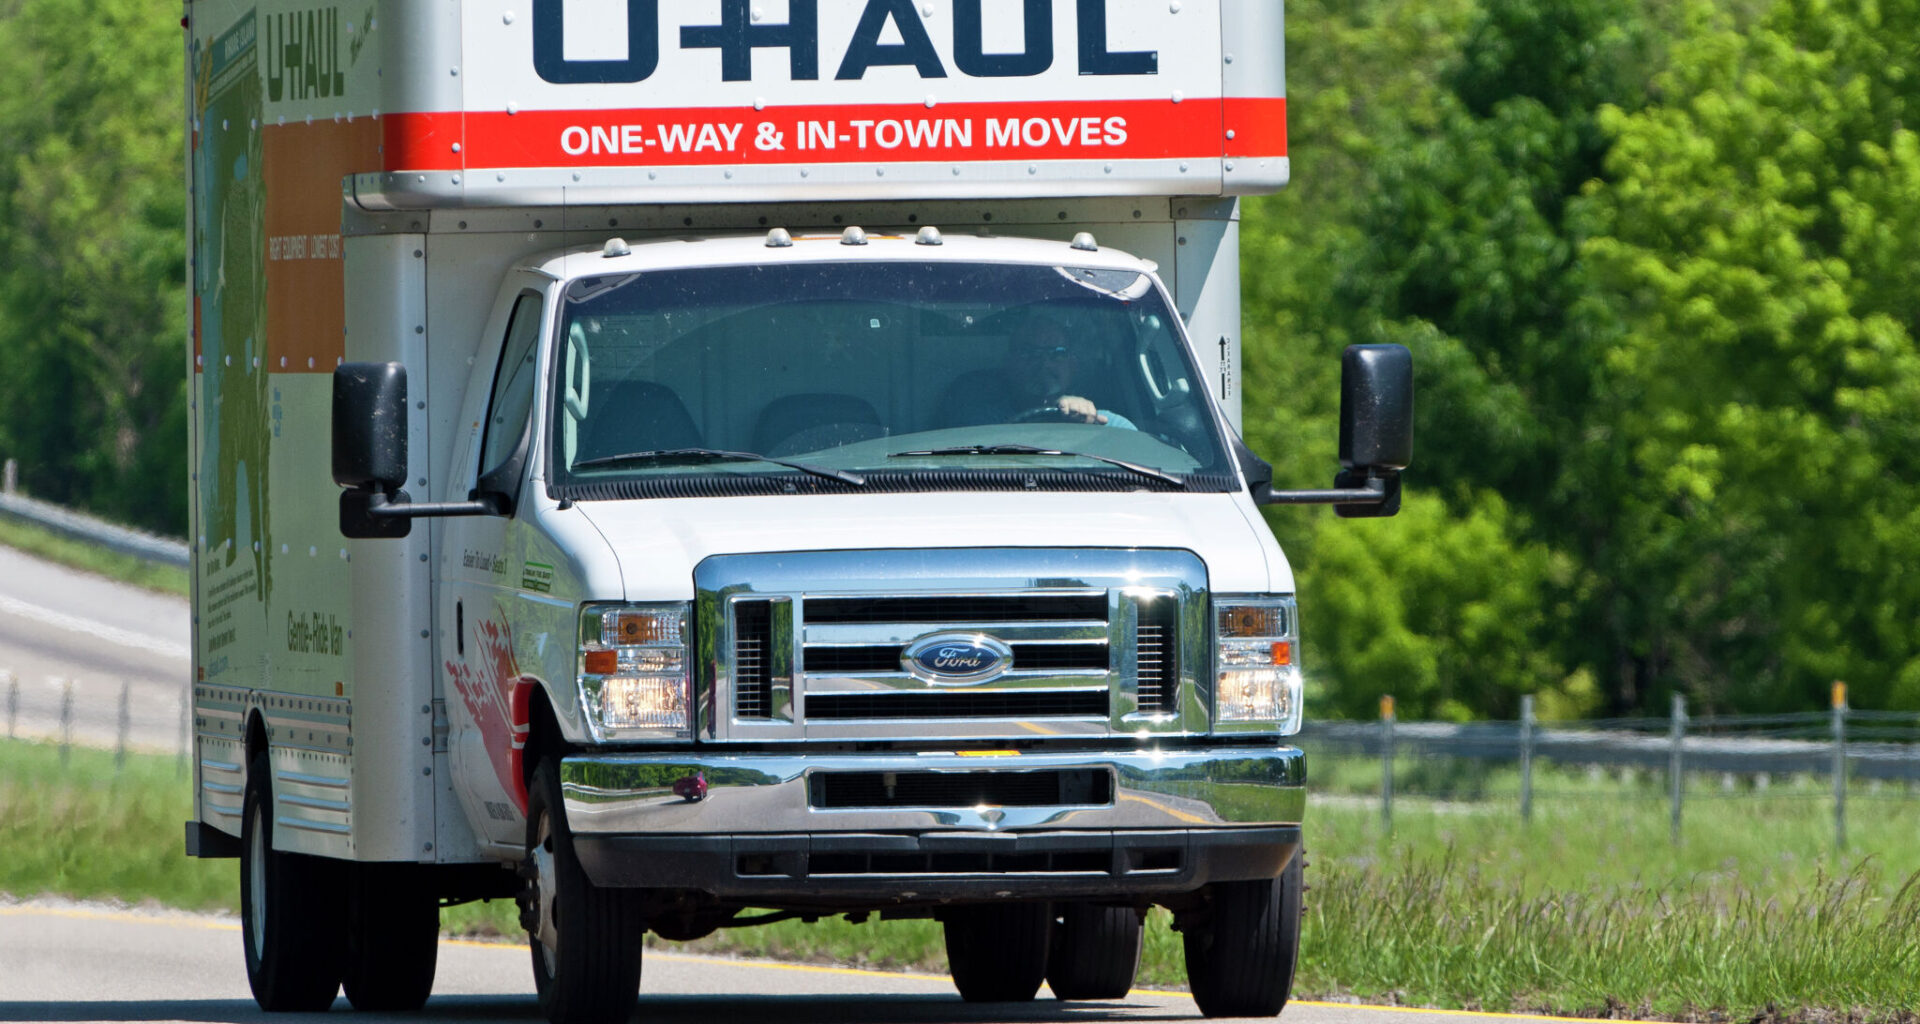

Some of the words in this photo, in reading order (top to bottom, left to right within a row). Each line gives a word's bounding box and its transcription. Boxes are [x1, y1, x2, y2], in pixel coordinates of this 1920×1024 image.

[267, 6, 344, 102] U-HAUL
[532, 0, 1158, 84] U-HAUL
[560, 122, 743, 155] ONE-WAY
[754, 121, 786, 151] &
[796, 118, 972, 150] IN-TOWN
[985, 115, 1128, 147] MOVES
[287, 609, 328, 654] Gentle-Ride
[329, 614, 343, 656] Van
[934, 646, 982, 668] Ford
